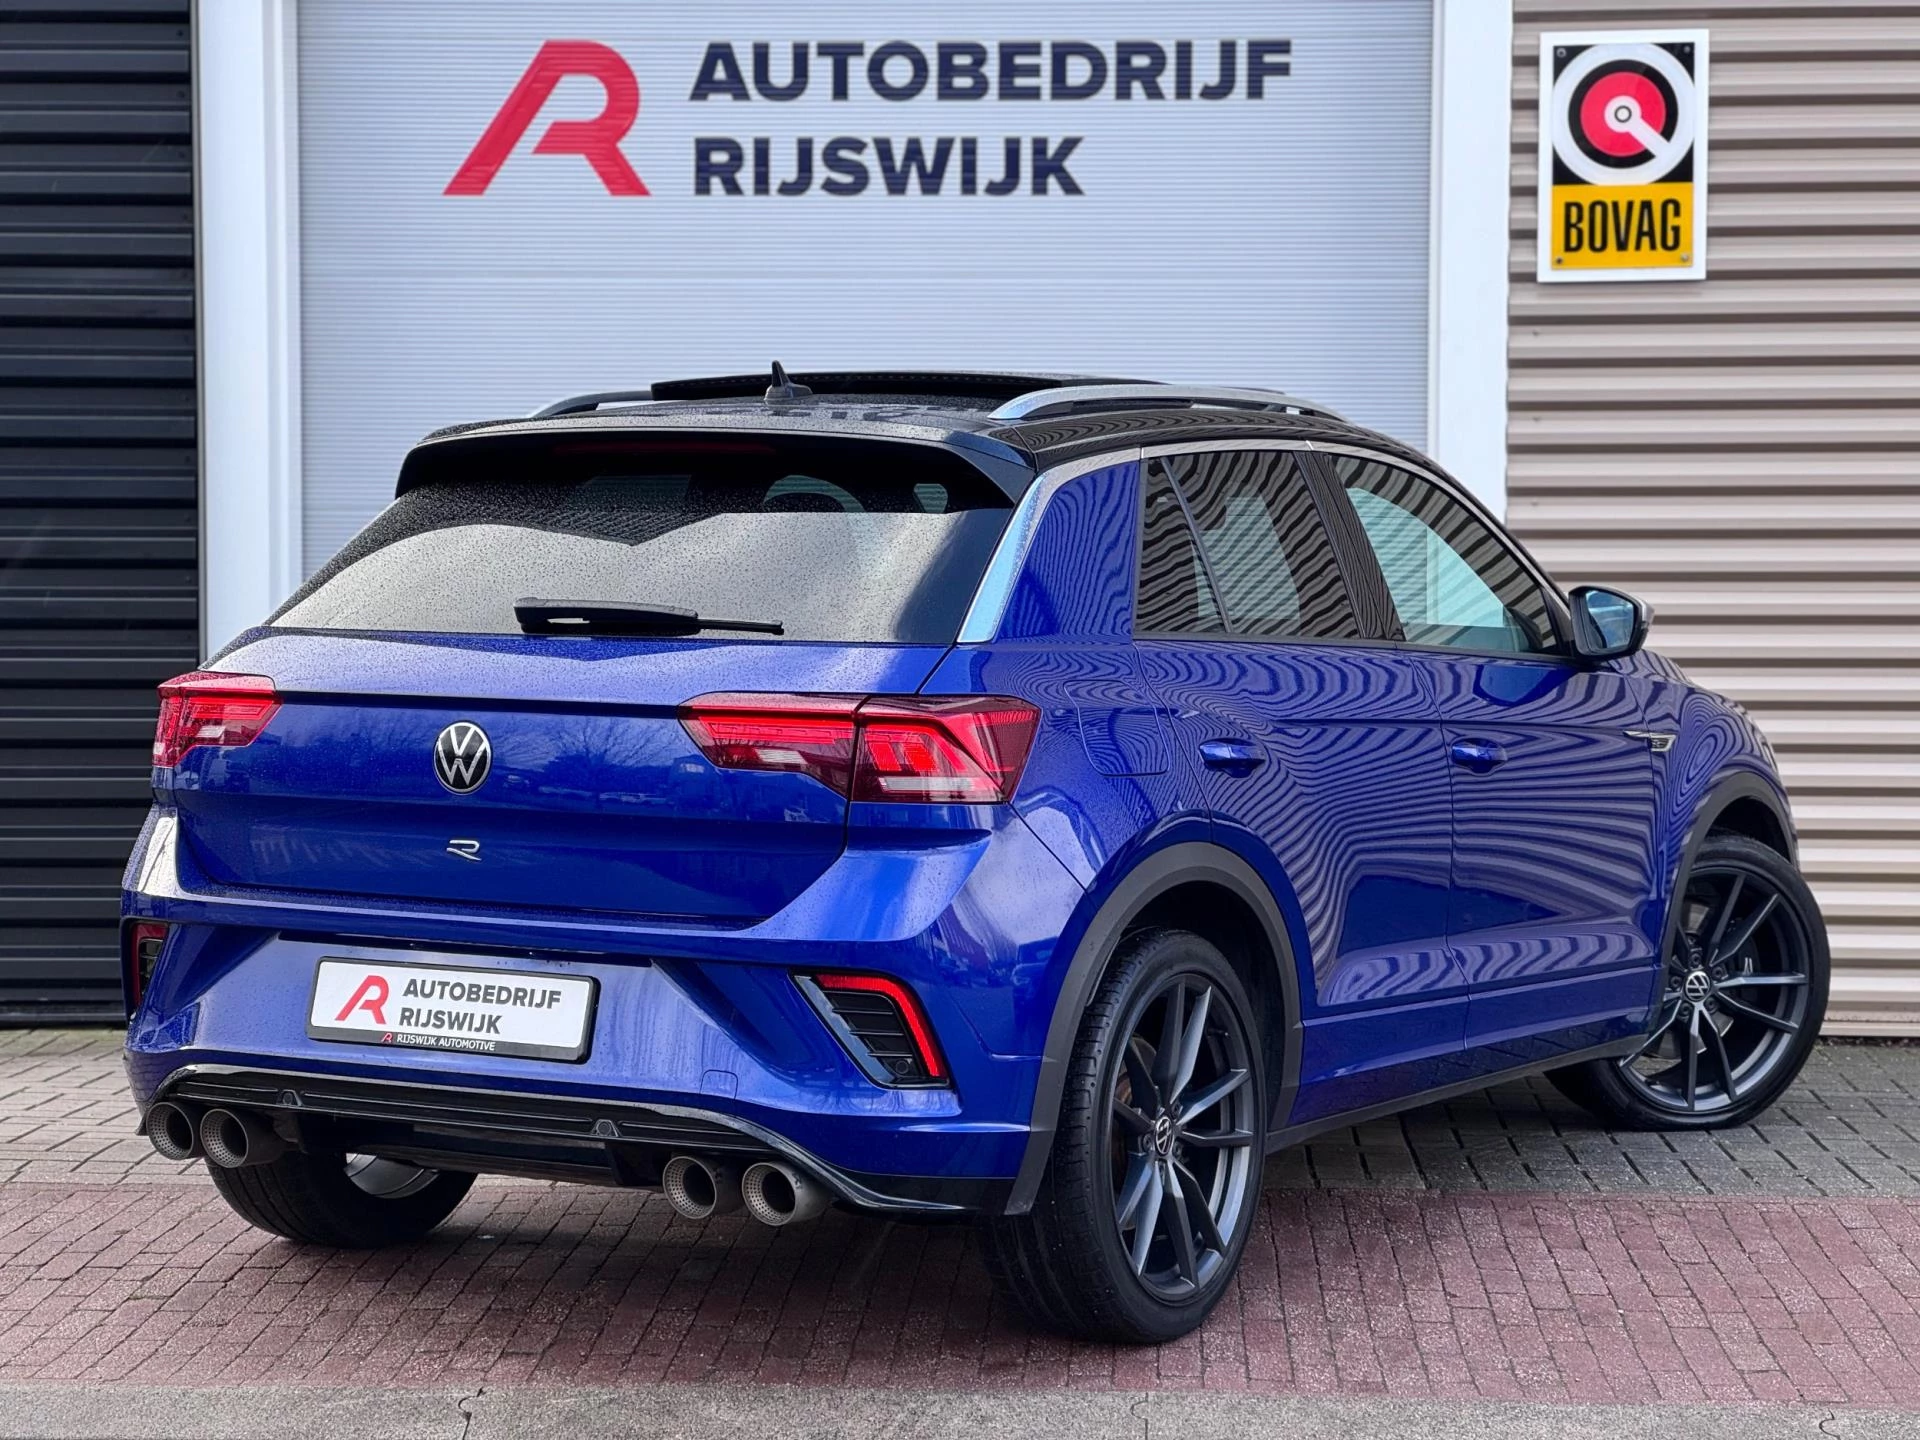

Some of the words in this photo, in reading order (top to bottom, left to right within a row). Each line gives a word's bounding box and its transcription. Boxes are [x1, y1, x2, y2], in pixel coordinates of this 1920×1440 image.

[689, 40, 1293, 102] AUTOBEDRIJF
[694, 136, 1085, 196] RIJSWIJK
[1563, 198, 1681, 253] BOVAG
[446, 839, 482, 861] R
[402, 978, 562, 1010] AUTOBEDRIJF
[398, 1007, 503, 1035] RIJSWIJK
[397, 1034, 438, 1047] RIJSWIJK
[440, 1037, 497, 1051] AUTOMOTIVE
